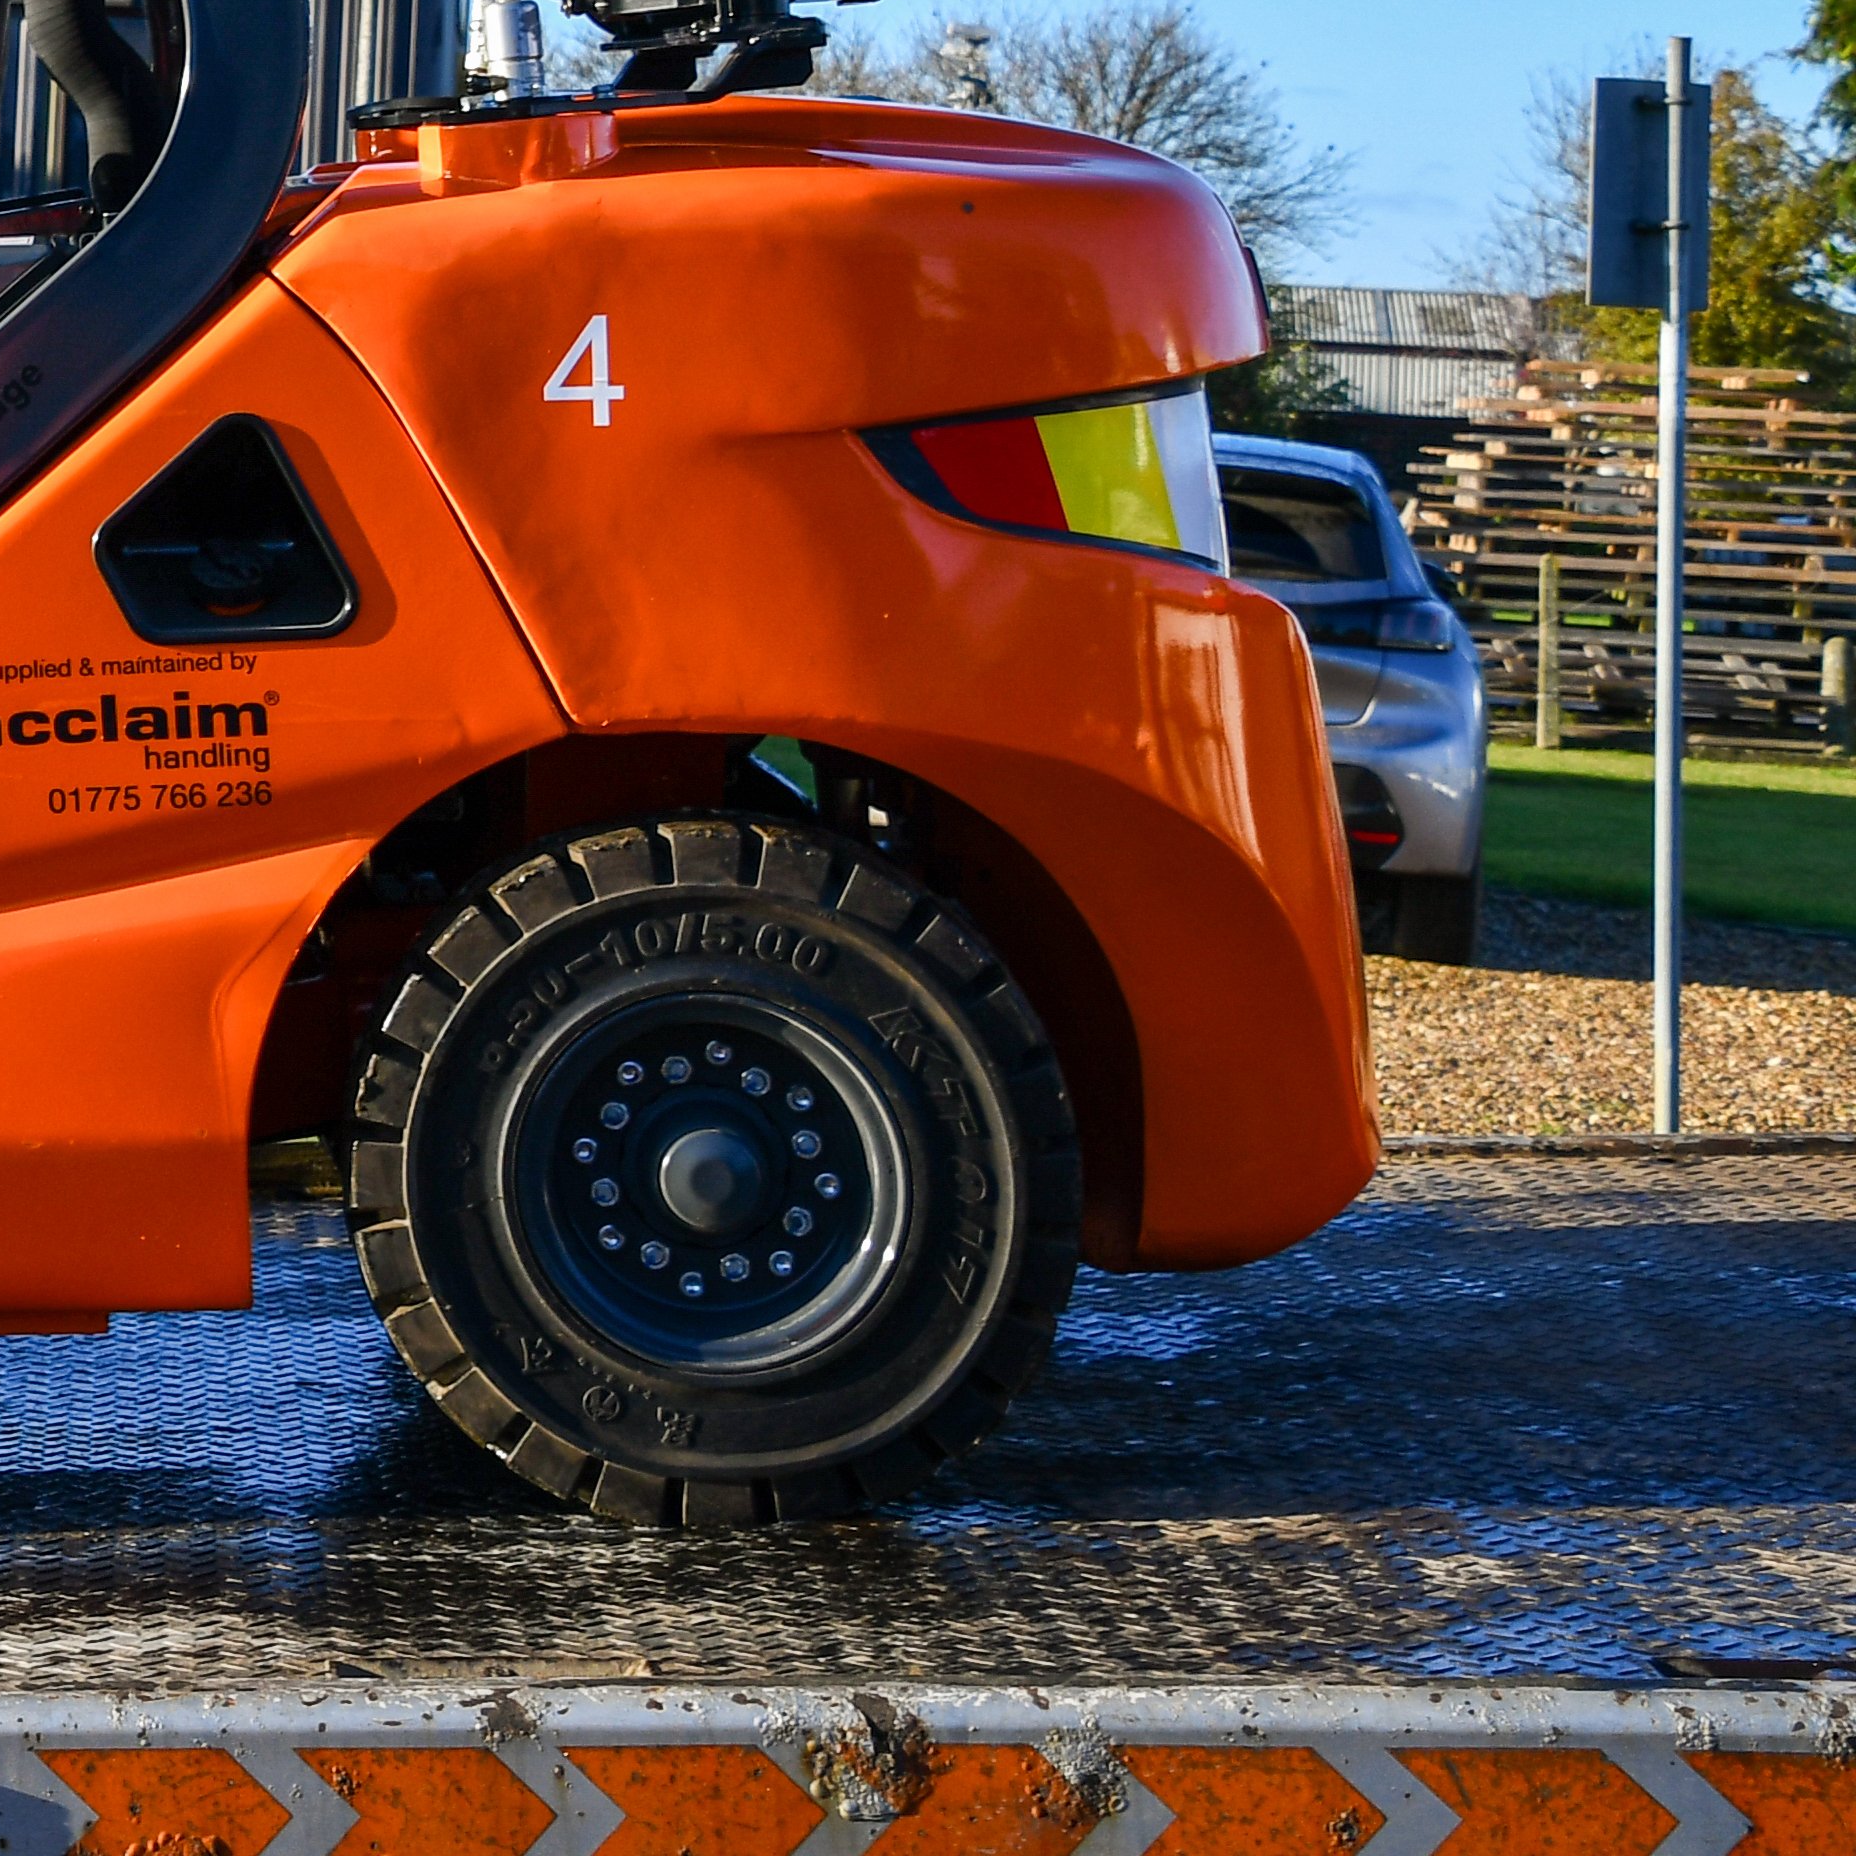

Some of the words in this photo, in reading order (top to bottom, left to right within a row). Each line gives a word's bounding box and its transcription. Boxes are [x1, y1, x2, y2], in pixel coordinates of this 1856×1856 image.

[543, 314, 625, 426] 4
[79, 658, 94, 676] &
[101, 651, 223, 675] maintained
[230, 650, 258, 674] by
[144, 742, 270, 773] handling
[48, 785, 141, 814] 01775
[150, 783, 207, 810] 766
[216, 780, 273, 807] 236
